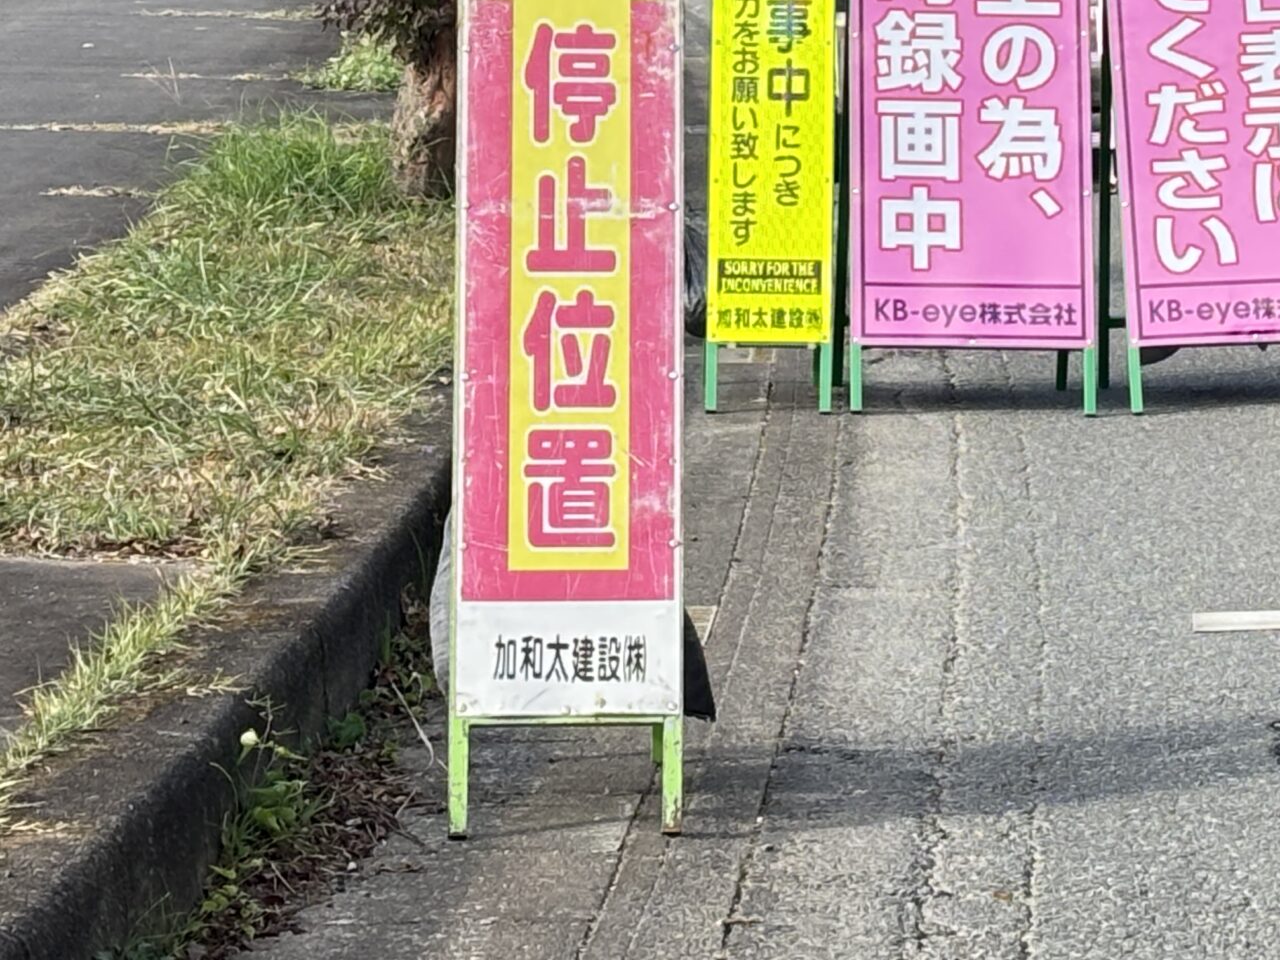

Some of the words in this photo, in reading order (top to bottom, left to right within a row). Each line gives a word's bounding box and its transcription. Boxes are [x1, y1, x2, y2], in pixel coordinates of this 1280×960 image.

[724, 261, 764, 276] SORRY
[766, 262, 790, 276] FOR
[792, 262, 816, 276] THE
[524, 21, 617, 549] 停止位置
[721, 278, 818, 293] INCONVENIENCE
[874, 298, 1077, 328] KB-eye株式会社
